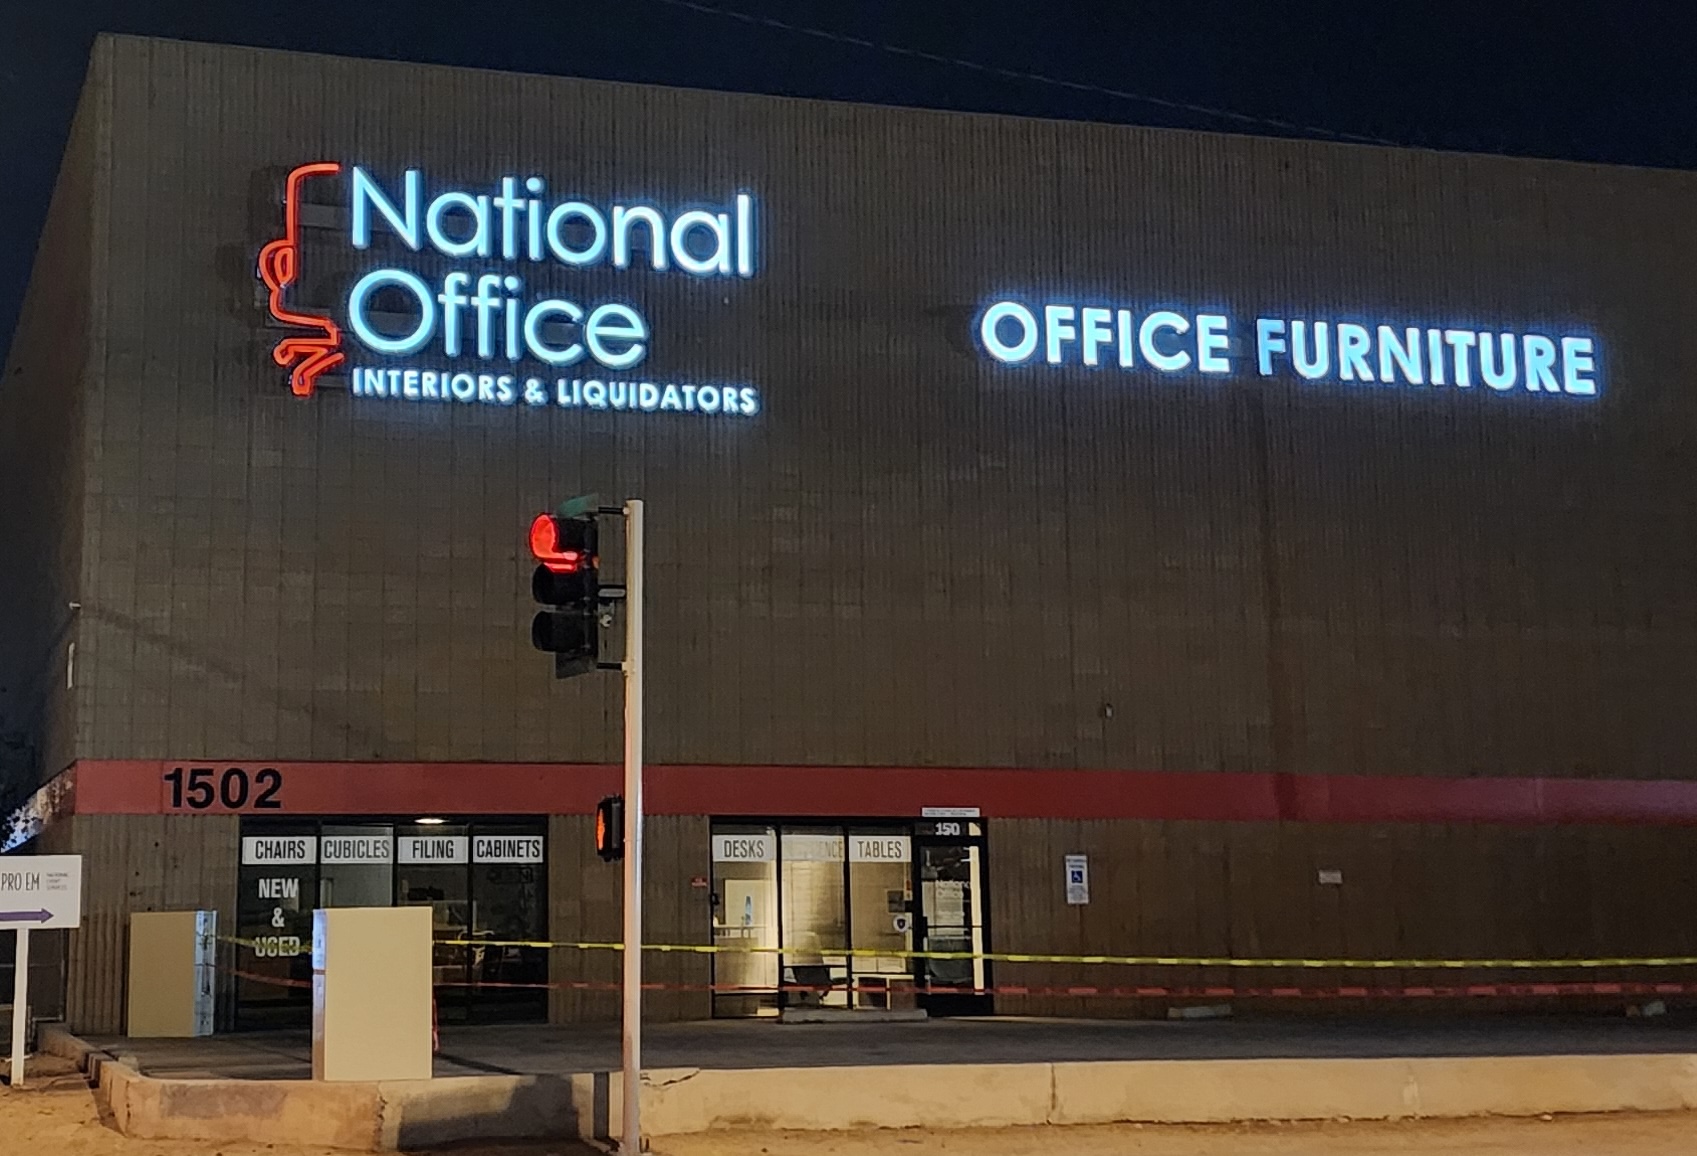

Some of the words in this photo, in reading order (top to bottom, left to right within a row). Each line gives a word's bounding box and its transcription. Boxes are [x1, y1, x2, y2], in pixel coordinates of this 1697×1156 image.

[352, 166, 751, 276] National
[348, 268, 646, 369] Office
[980, 301, 1231, 374] OFFICE
[1256, 317, 1597, 395] FURNITURE
[352, 367, 512, 401] INTERIORS
[523, 380, 545, 404] &
[557, 378, 759, 416] LIQUIDATORS
[163, 766, 283, 810] 1502
[254, 839, 306, 860] CHAIRS
[323, 839, 390, 860] CUBICLES
[411, 839, 455, 860] FILING
[476, 838, 541, 859] CABINETS
[723, 839, 765, 859] DESKS
[857, 840, 903, 859] TABLES
[1, 872, 22, 891] PRO
[25, 871, 40, 891] EM
[258, 878, 299, 898] NEW
[271, 906, 285, 928] &
